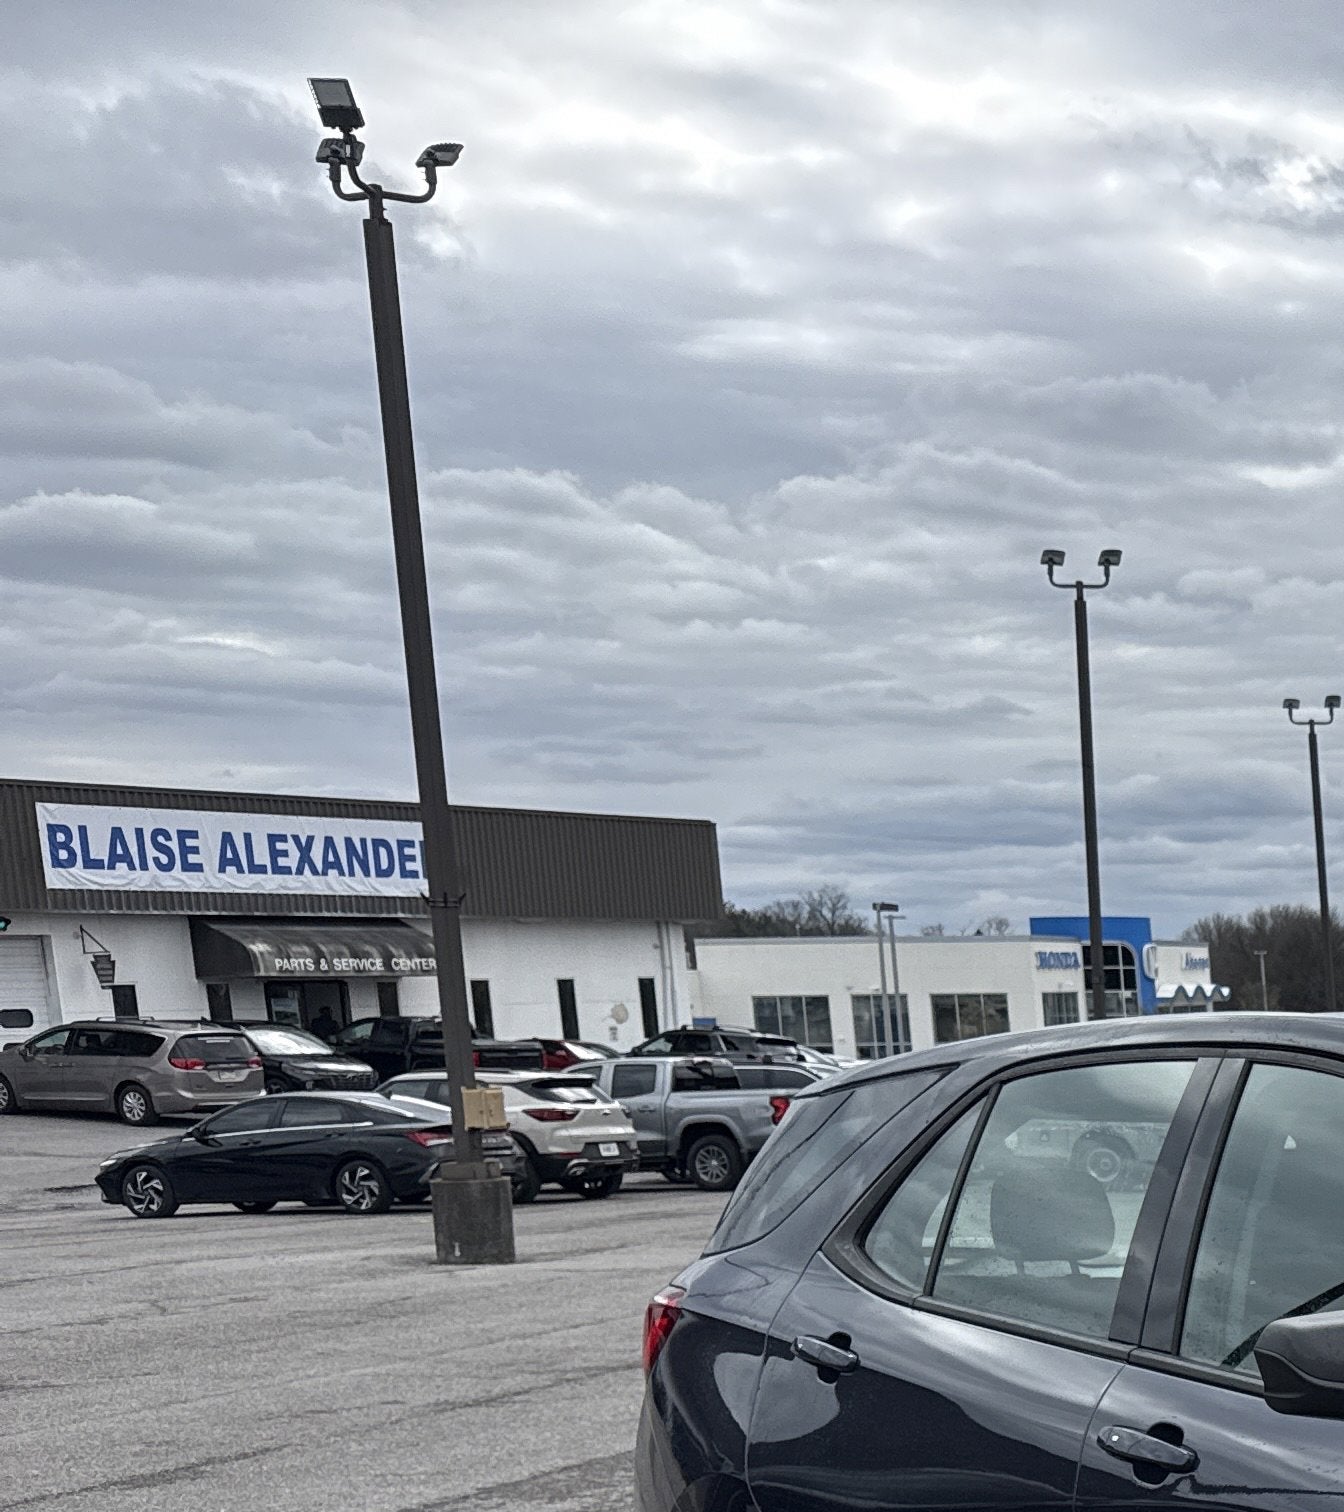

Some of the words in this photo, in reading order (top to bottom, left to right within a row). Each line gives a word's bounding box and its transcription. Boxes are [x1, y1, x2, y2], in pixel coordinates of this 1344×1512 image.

[46, 823, 204, 873] BLAISE
[217, 831, 427, 879] ALEXANDE
[274, 957, 315, 971] PARTS
[319, 957, 329, 971] &
[333, 957, 384, 971] SERVICE
[391, 957, 437, 971] CENTER
